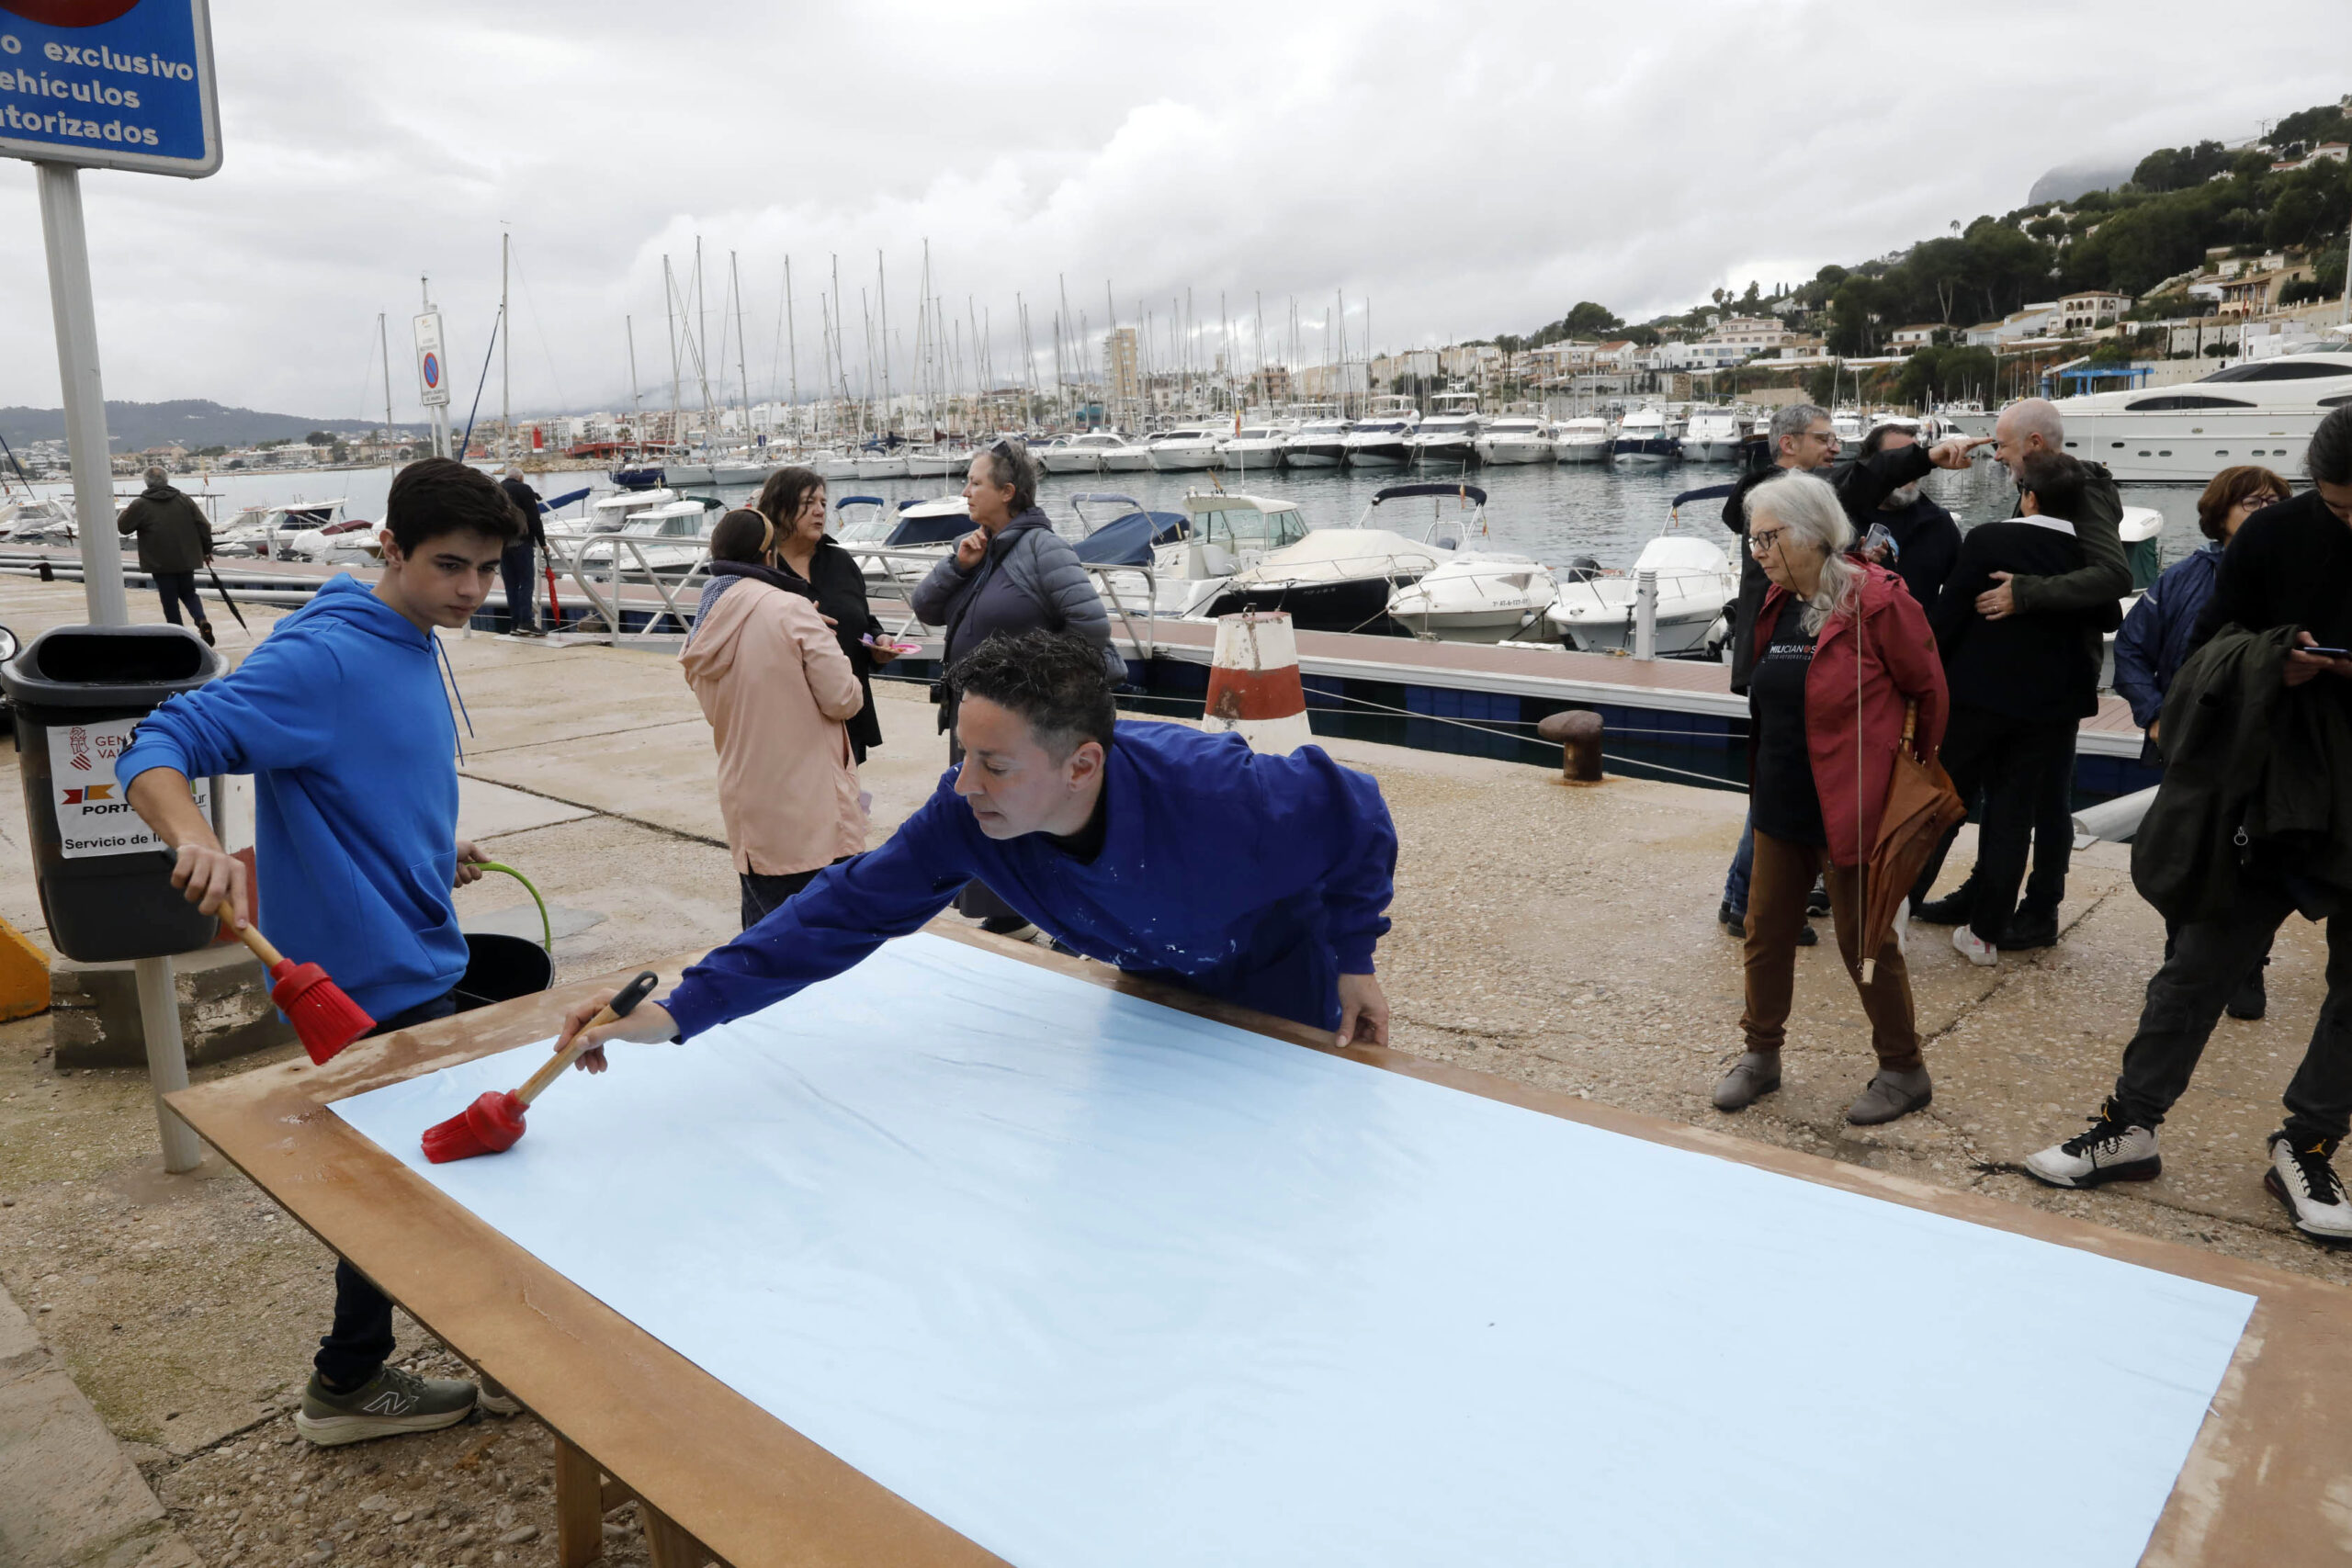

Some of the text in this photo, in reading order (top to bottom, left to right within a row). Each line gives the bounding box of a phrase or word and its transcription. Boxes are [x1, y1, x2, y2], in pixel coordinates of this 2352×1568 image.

[44, 41, 194, 81] exclusivo
[0, 104, 159, 145] torizados
[82, 804, 136, 815] PORT
[65, 836, 126, 850] Servicio
[130, 834, 148, 844] de
